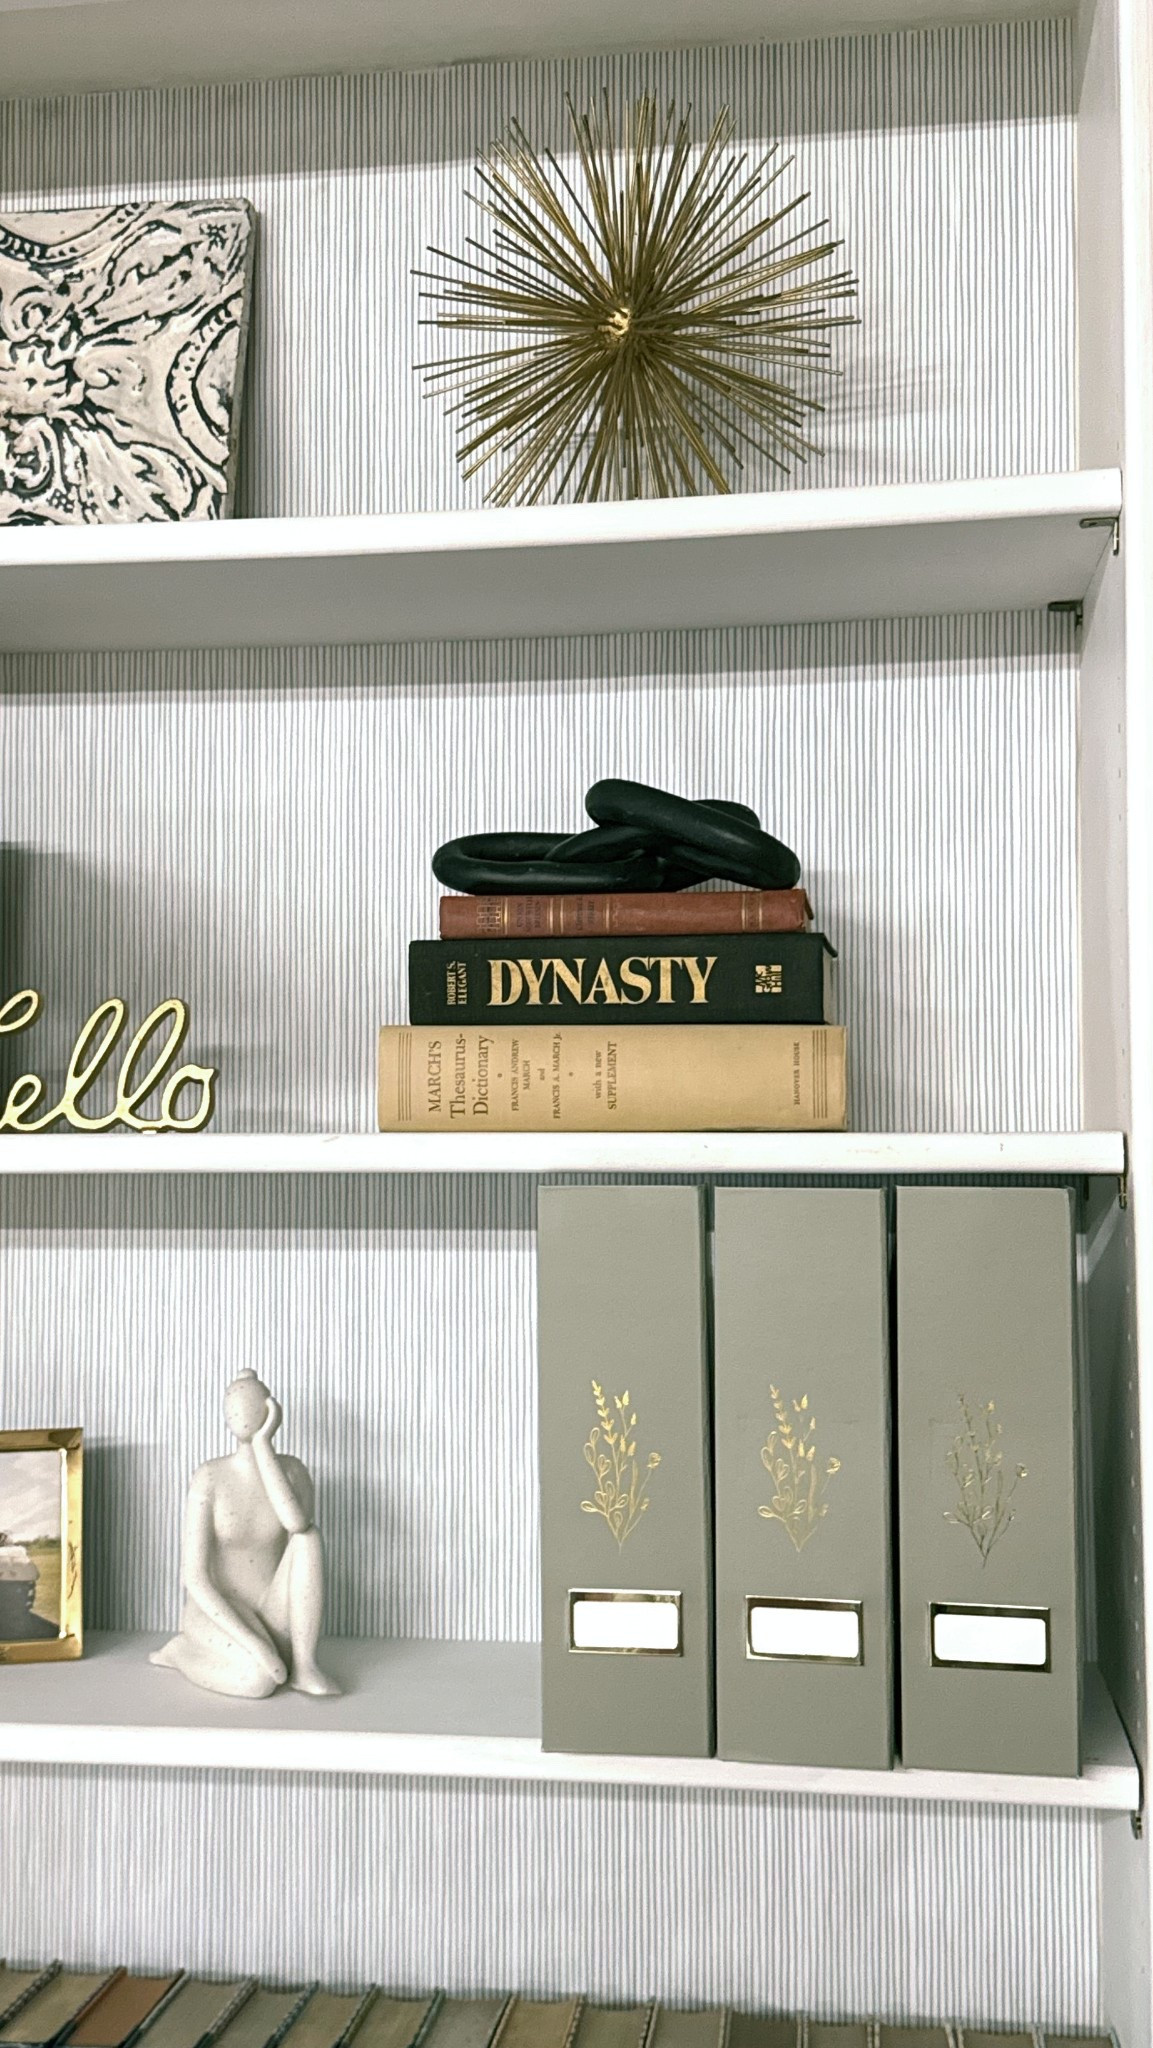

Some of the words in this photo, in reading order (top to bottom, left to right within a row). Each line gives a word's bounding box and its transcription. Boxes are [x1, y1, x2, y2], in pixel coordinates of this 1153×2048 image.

[446, 971, 456, 1006] ROBERT
[457, 961, 467, 1005] ELEGANT
[486, 956, 718, 1007] DYNASTY
[511, 1039, 519, 1075] ANDREW
[537, 1068, 545, 1081] and
[553, 1041, 561, 1073] MARCH
[428, 1040, 442, 1112] MARCH'S
[450, 1033, 467, 1119] Thesaurus-
[473, 1035, 494, 1116] Dictionary
[522, 1060, 530, 1091] MARCH
[592, 1079, 602, 1099] with
[607, 1041, 617, 1110] SUPPLEMENT
[511, 1076, 520, 1111] FRANCIS
[553, 1084, 562, 1119] FRANCIS
